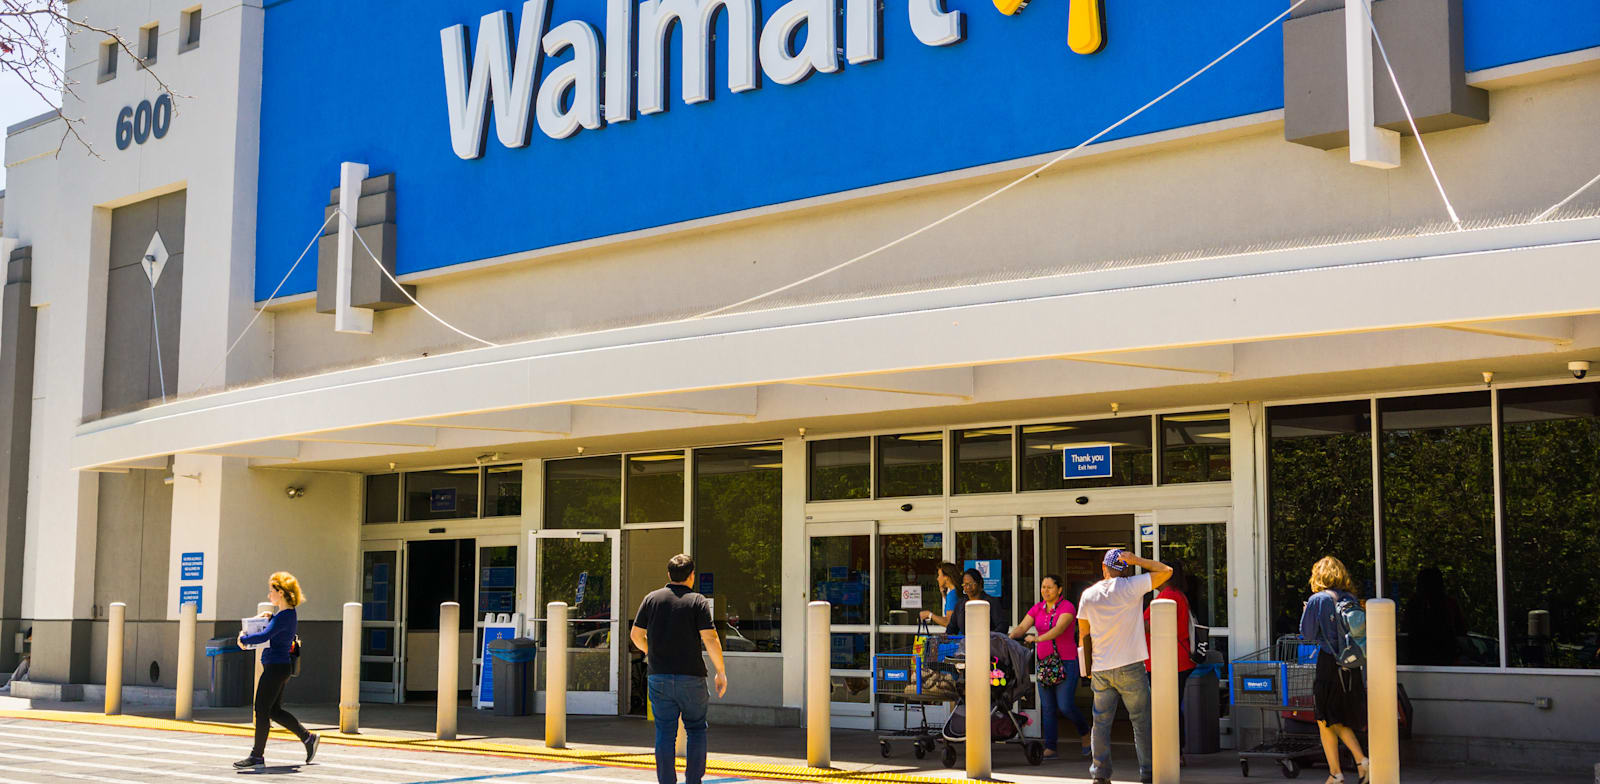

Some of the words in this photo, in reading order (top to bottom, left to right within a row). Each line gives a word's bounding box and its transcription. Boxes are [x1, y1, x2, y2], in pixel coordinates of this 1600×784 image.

[116, 93, 171, 151] 600
[1072, 454, 1091, 463] Thank
[1092, 455, 1104, 464] you
